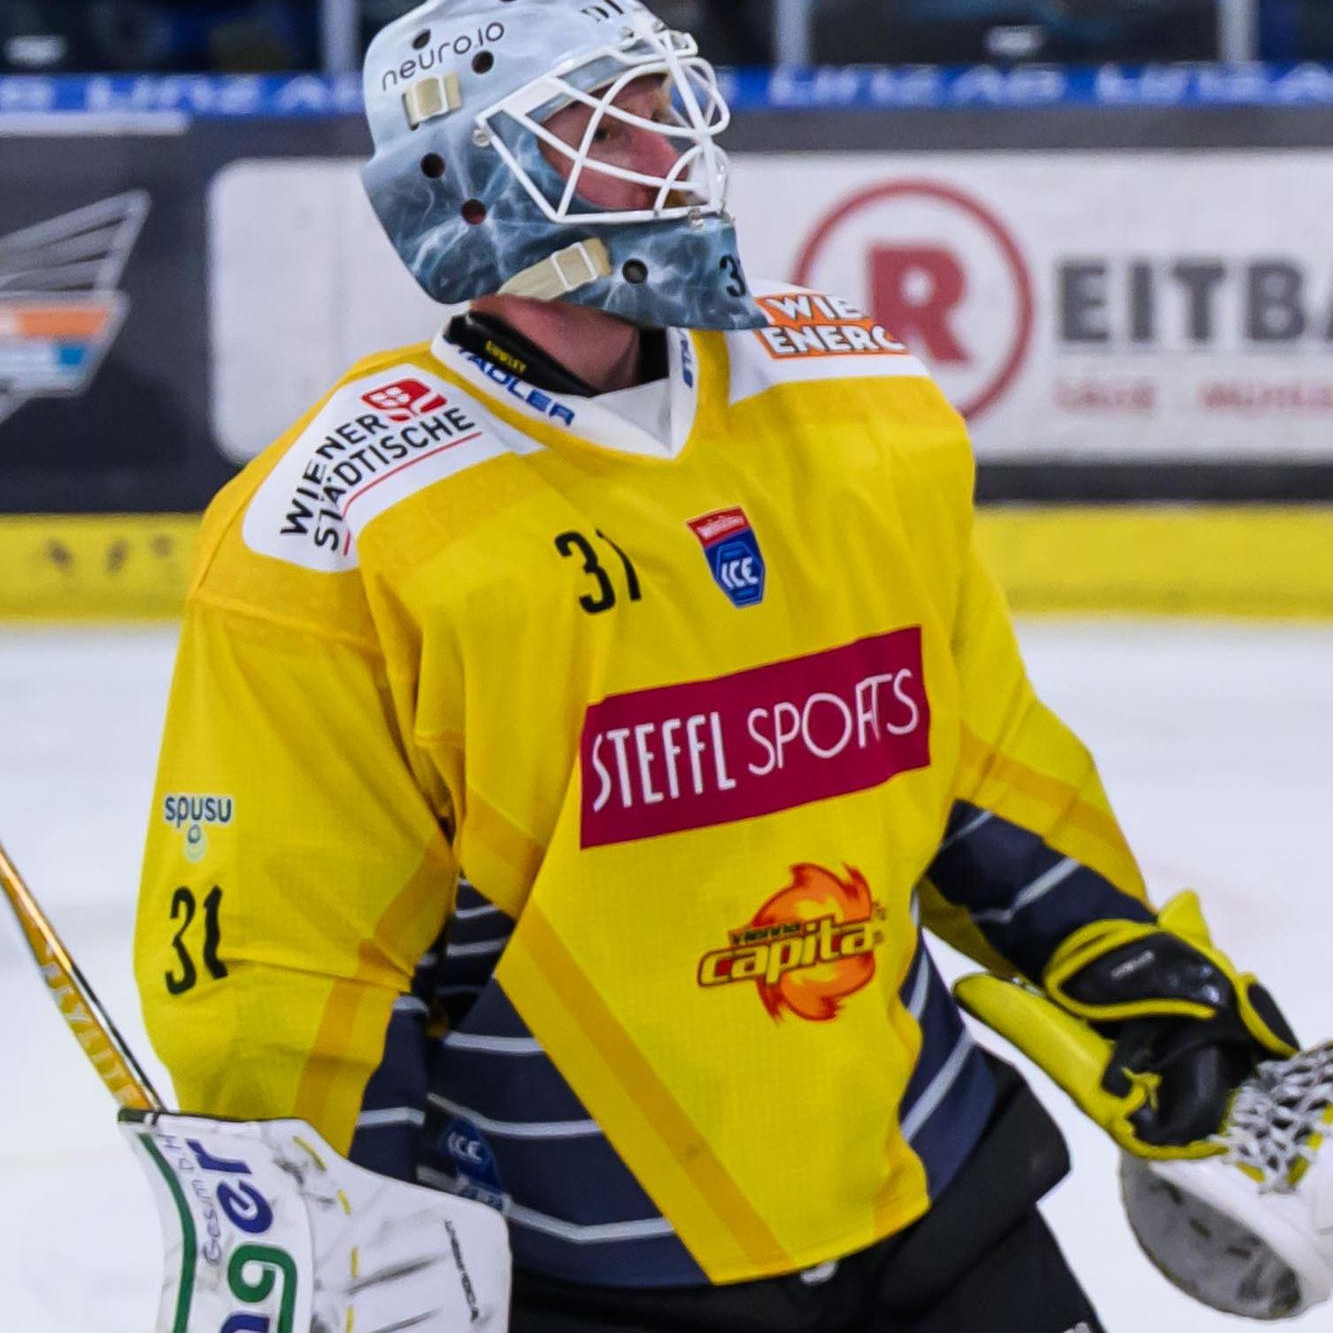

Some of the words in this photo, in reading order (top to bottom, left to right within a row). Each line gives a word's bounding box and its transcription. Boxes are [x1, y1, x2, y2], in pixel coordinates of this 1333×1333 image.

[278, 412, 390, 536] WIENER
[553, 528, 642, 616] 31
[720, 556, 760, 591] ICE
[591, 710, 738, 814] STEFFL
[164, 794, 233, 829] spusu
[164, 883, 230, 996] 31
